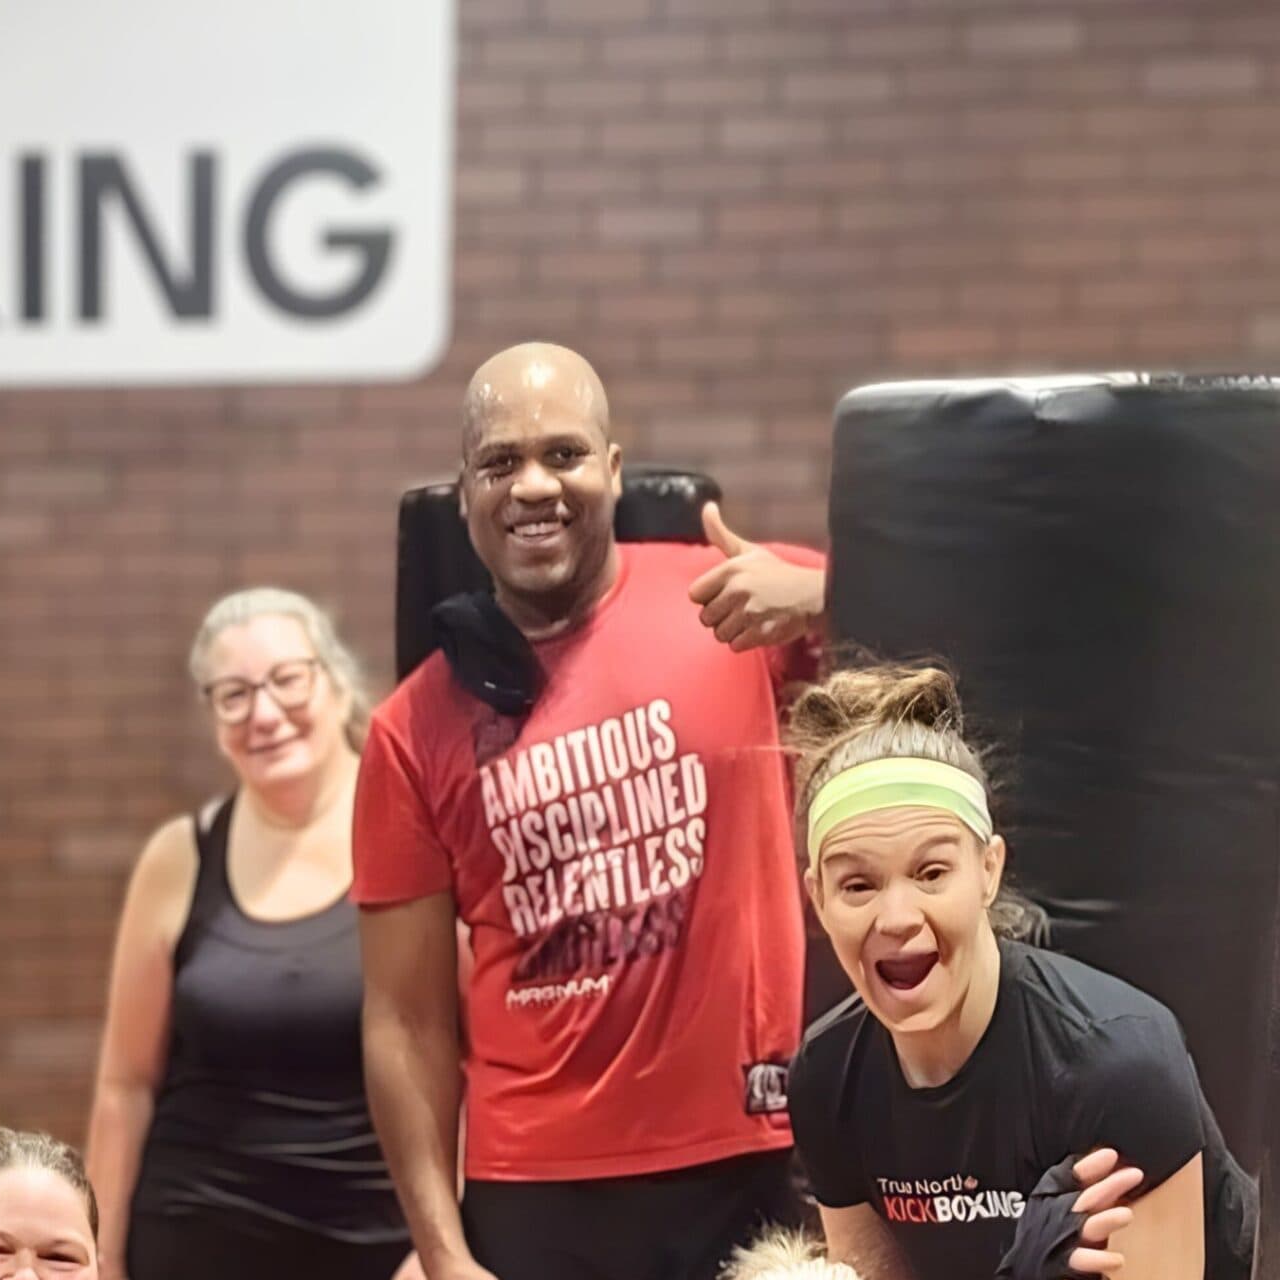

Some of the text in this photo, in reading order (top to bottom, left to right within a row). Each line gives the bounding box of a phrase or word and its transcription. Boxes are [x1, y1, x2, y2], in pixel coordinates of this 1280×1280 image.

[479, 697, 677, 828] AMBITIOUS
[490, 753, 708, 882] DISCIPLINED
[502, 817, 707, 939] RELENTLESS
[883, 1190, 1026, 1223] KICKBOXING
